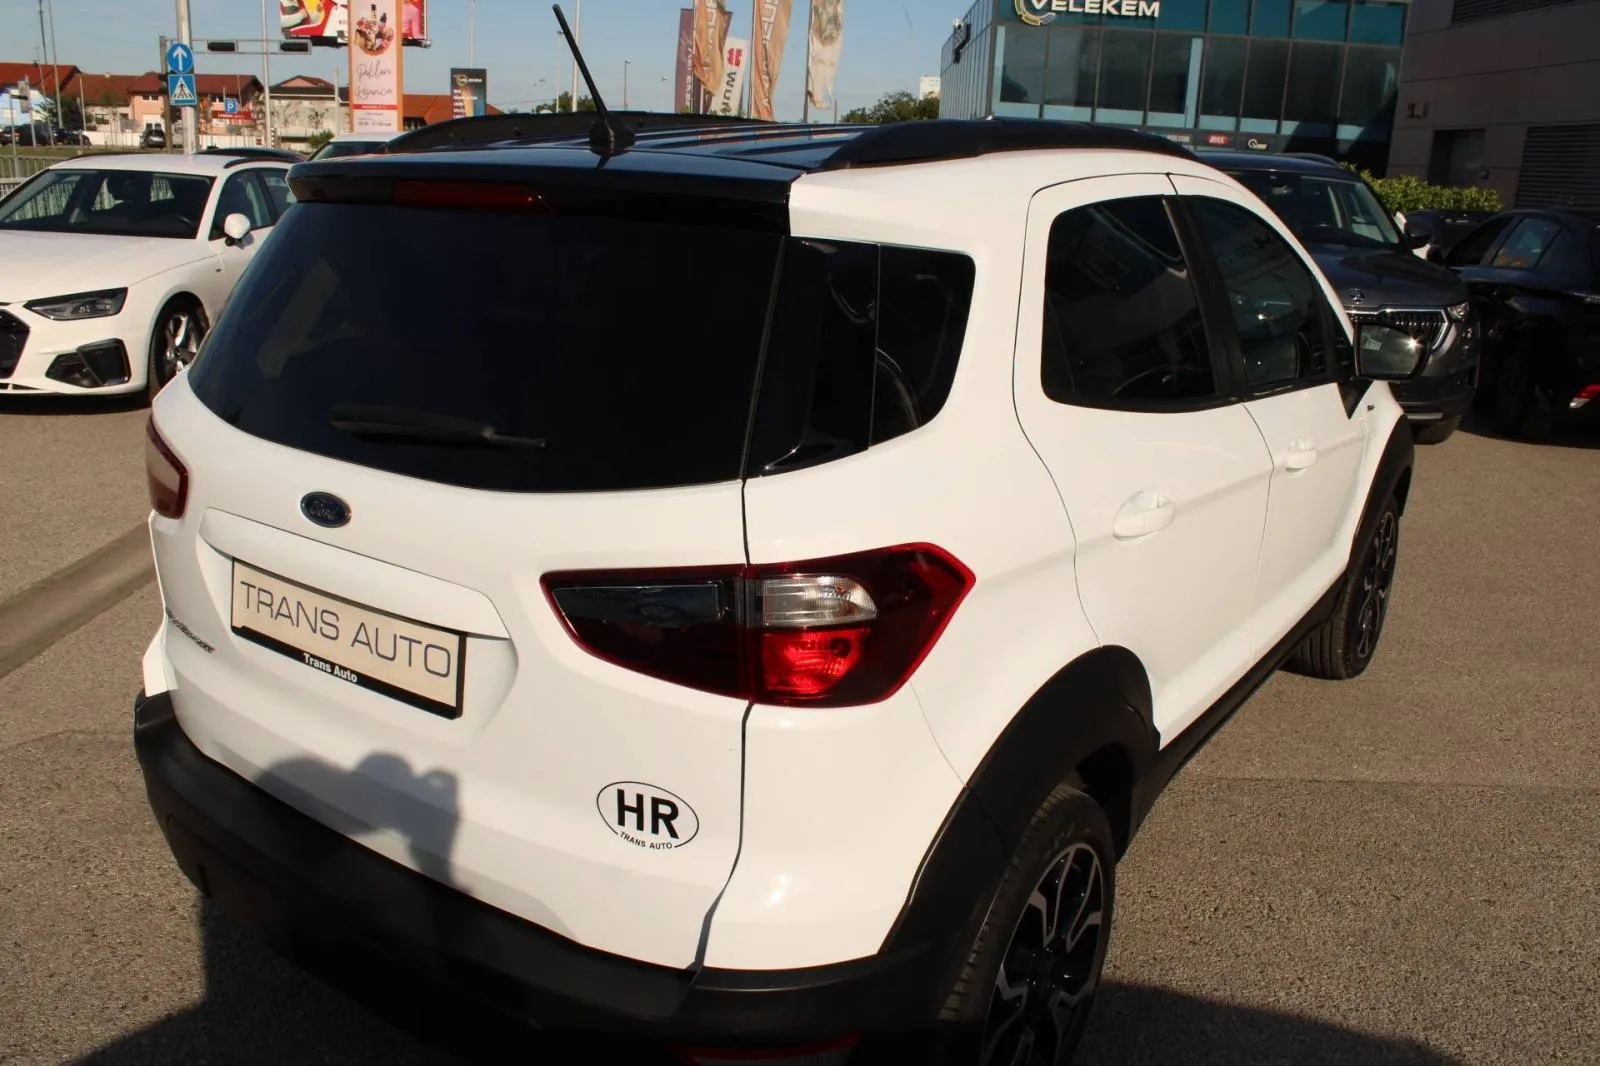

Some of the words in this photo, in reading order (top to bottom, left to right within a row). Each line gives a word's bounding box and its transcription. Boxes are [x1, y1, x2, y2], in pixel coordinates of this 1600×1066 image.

[1032, 0, 1160, 17] VELEKEM
[227, 103, 234, 112] P
[240, 580, 339, 641] TRANS
[351, 622, 451, 678] AUTO
[303, 652, 332, 674] Trans
[333, 663, 358, 683] Auto
[617, 788, 680, 840] HR
[620, 831, 646, 848] TRANS
